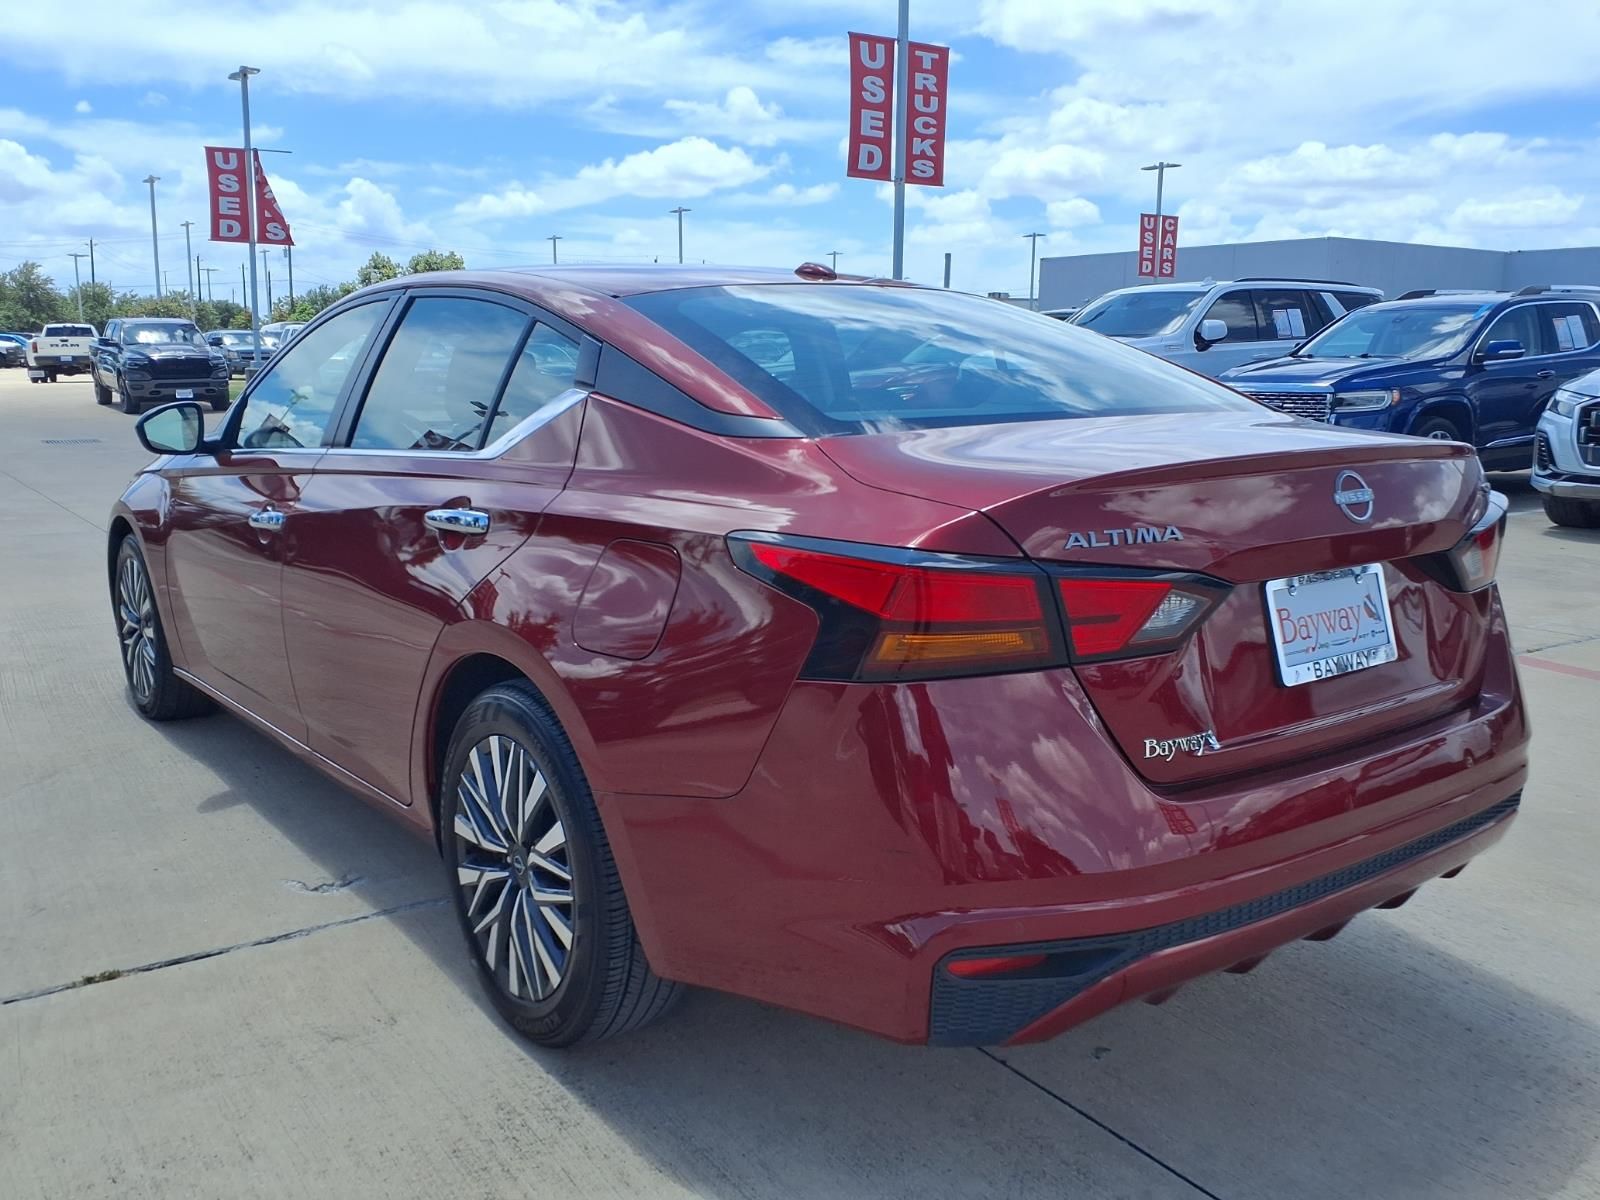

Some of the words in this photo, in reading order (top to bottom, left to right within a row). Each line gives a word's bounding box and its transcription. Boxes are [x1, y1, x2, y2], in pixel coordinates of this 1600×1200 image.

[857, 40, 886, 172] USED
[911, 50, 939, 179] TRUCKS
[214, 151, 242, 238] USED
[1141, 216, 1155, 273] USED
[1162, 218, 1175, 274] CARS
[1335, 490, 1374, 504] NISSA
[1064, 525, 1185, 550] ALTIMA
[1275, 604, 1361, 652] Bayway
[1312, 651, 1371, 679] BAYWAY
[1143, 732, 1209, 762] Bayway
